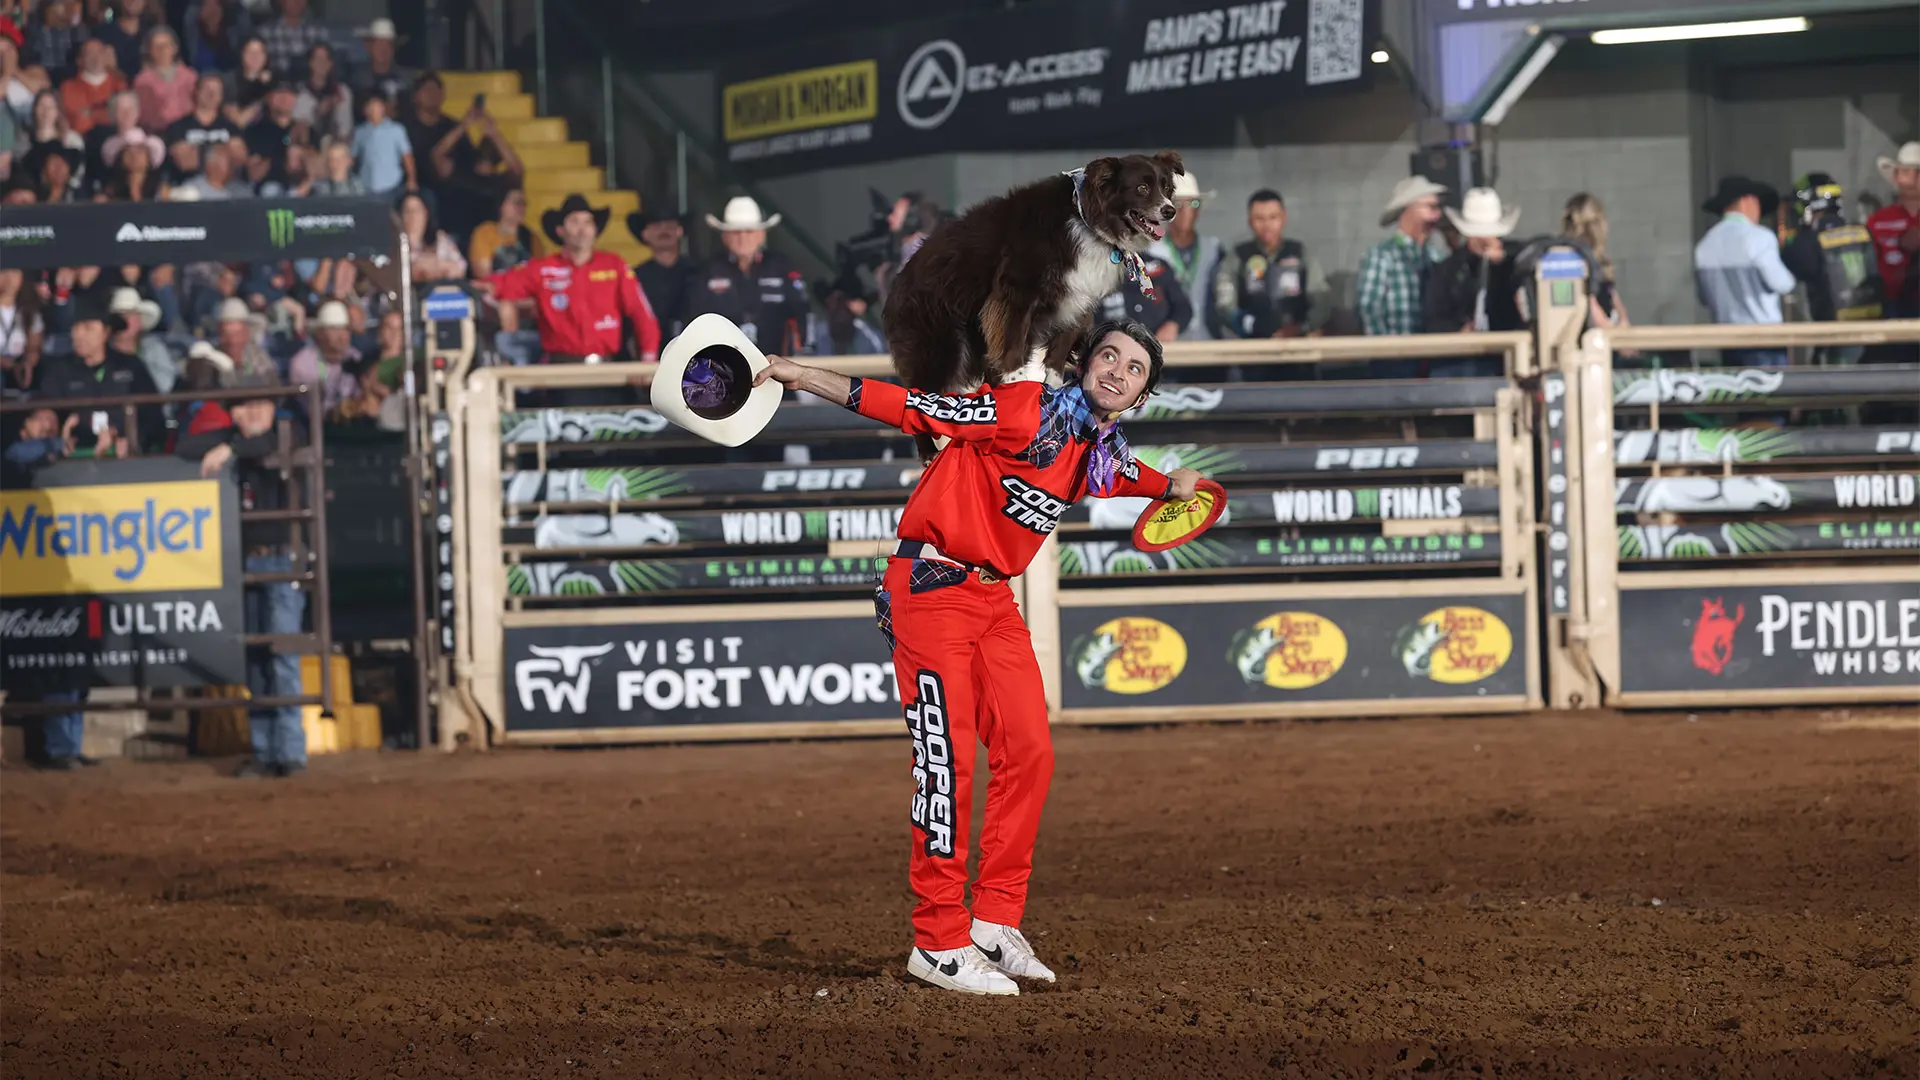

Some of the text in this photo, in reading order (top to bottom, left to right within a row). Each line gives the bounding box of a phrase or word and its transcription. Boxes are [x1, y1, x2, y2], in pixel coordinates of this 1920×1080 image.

[1145, 0, 1287, 53] RAMPS THAT
[1126, 35, 1301, 94] MAKE LIFE EASY
[906, 391, 997, 422] OOPER
[1314, 446, 1420, 470] PBR
[762, 468, 867, 491] PBR
[1834, 474, 1915, 508] WORLD
[1006, 498, 1056, 532] TIRE
[1272, 486, 1462, 523] WORLD FINALS
[0, 497, 212, 582] Wrangler
[722, 511, 802, 544] WORLD
[1819, 521, 1920, 538] ELIMIN
[1256, 534, 1484, 554] ELIMINATIONS
[706, 558, 889, 577] ELIMINATIO
[109, 599, 224, 635] ULTRA
[1117, 618, 1160, 642] Bass
[1277, 614, 1320, 637] Bass
[1443, 608, 1485, 631] Bass
[1755, 595, 1920, 656] PENDLE
[8, 648, 188, 669] SUPERIOR LIGHT BEER
[624, 636, 743, 665] VISIT
[1444, 651, 1499, 674] Shops
[1813, 649, 1920, 675] WHISK
[1118, 661, 1173, 687] Shops
[1279, 656, 1334, 681] Shops
[616, 662, 902, 711] FORT WORT
[918, 674, 952, 854] COOPER
